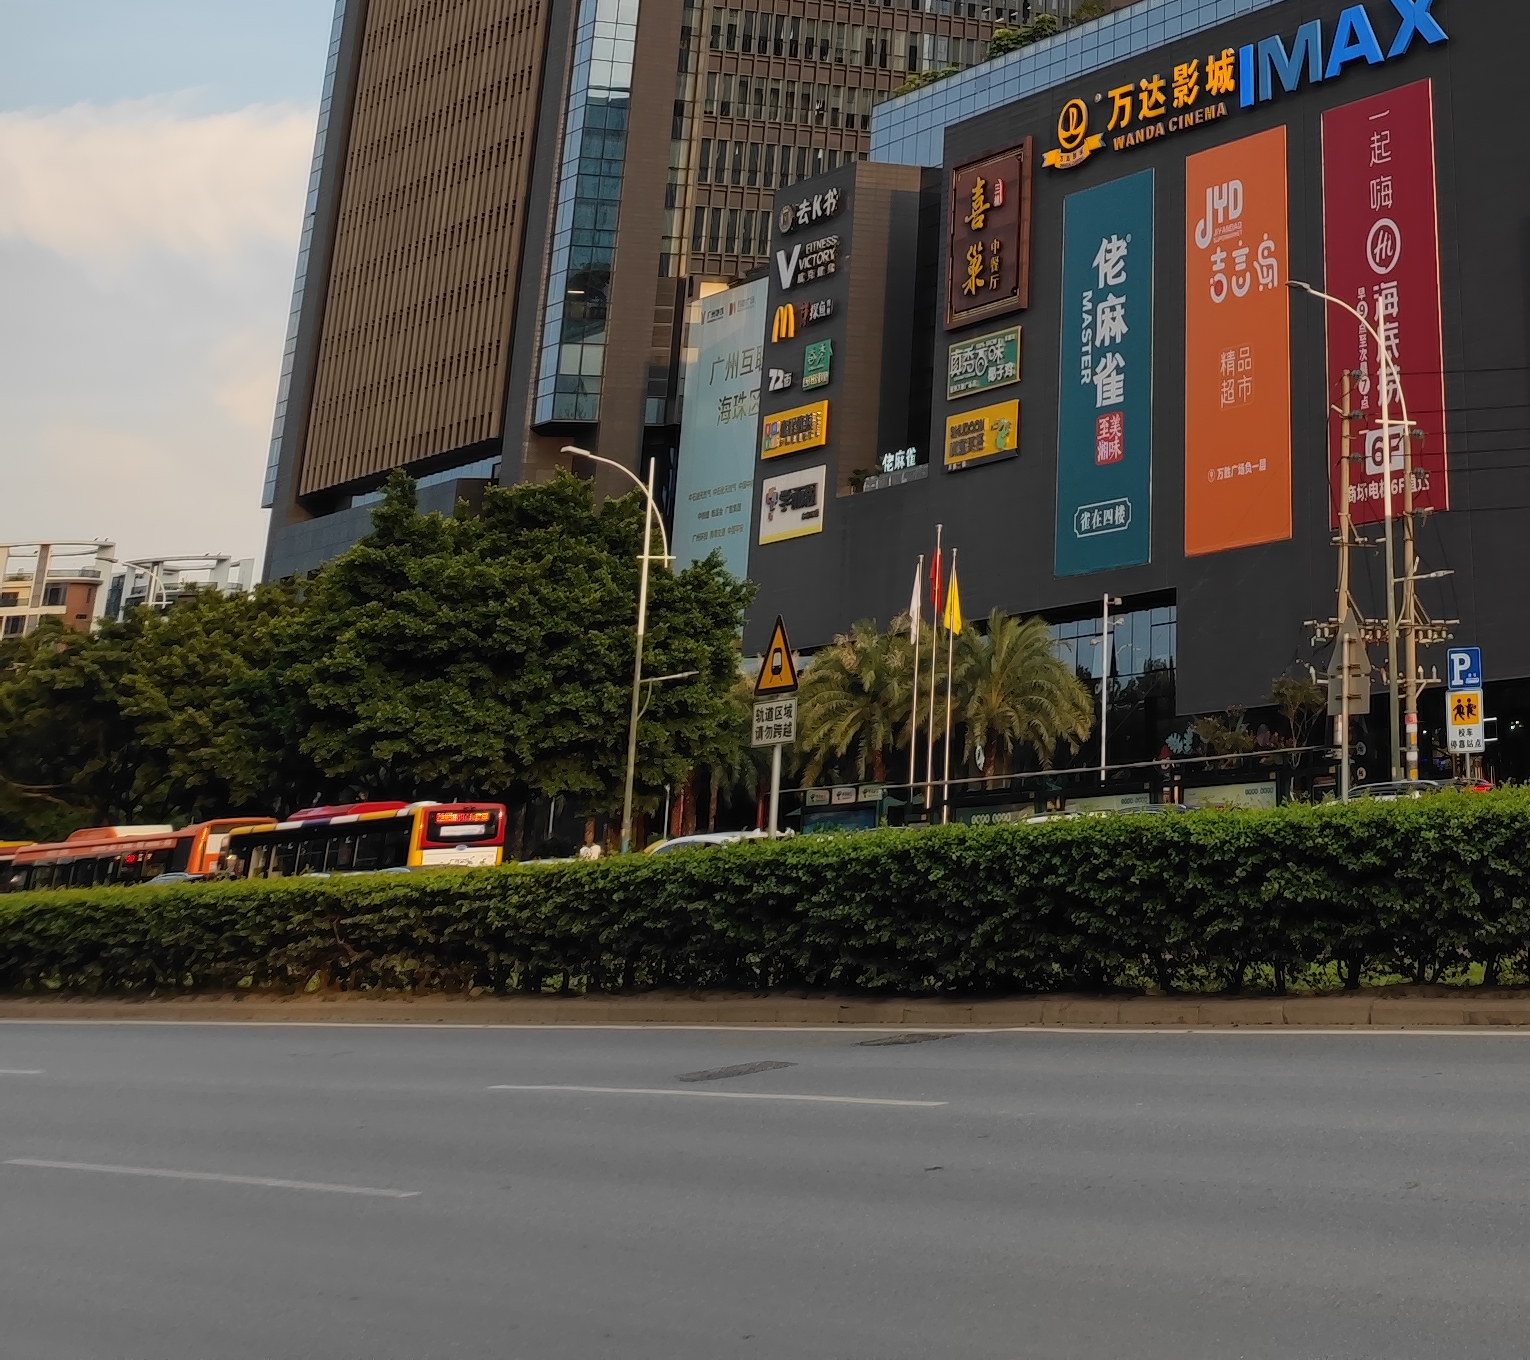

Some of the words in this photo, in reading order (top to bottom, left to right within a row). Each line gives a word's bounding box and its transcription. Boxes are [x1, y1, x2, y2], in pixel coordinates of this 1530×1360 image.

[1106, 47, 1236, 131] 万达影城
[1112, 121, 1165, 152] WANDA
[1168, 101, 1228, 131] CINEMA
[1368, 109, 1393, 212] 一起嗨
[1195, 180, 1243, 249] JYD
[799, 247, 836, 270] VICTORY
[805, 234, 838, 255] FITNESS
[1373, 229, 1394, 263] Hi
[1092, 234, 1129, 408] 佬麻雀
[1080, 289, 1093, 385] MASTER
[1220, 346, 1252, 376] 精品
[1220, 375, 1253, 408] 超市
[882, 447, 917, 473] 佬麻雀
[1216, 458, 1267, 480] 万胜广场负一层
[1079, 502, 1127, 532] 雀在四楼
[1450, 652, 1471, 686] P
[756, 704, 793, 723] 轨道区域
[754, 723, 792, 742] 请勿跨越
[1450, 738, 1482, 750] 停靠站点
[1458, 728, 1474, 738] 校车
